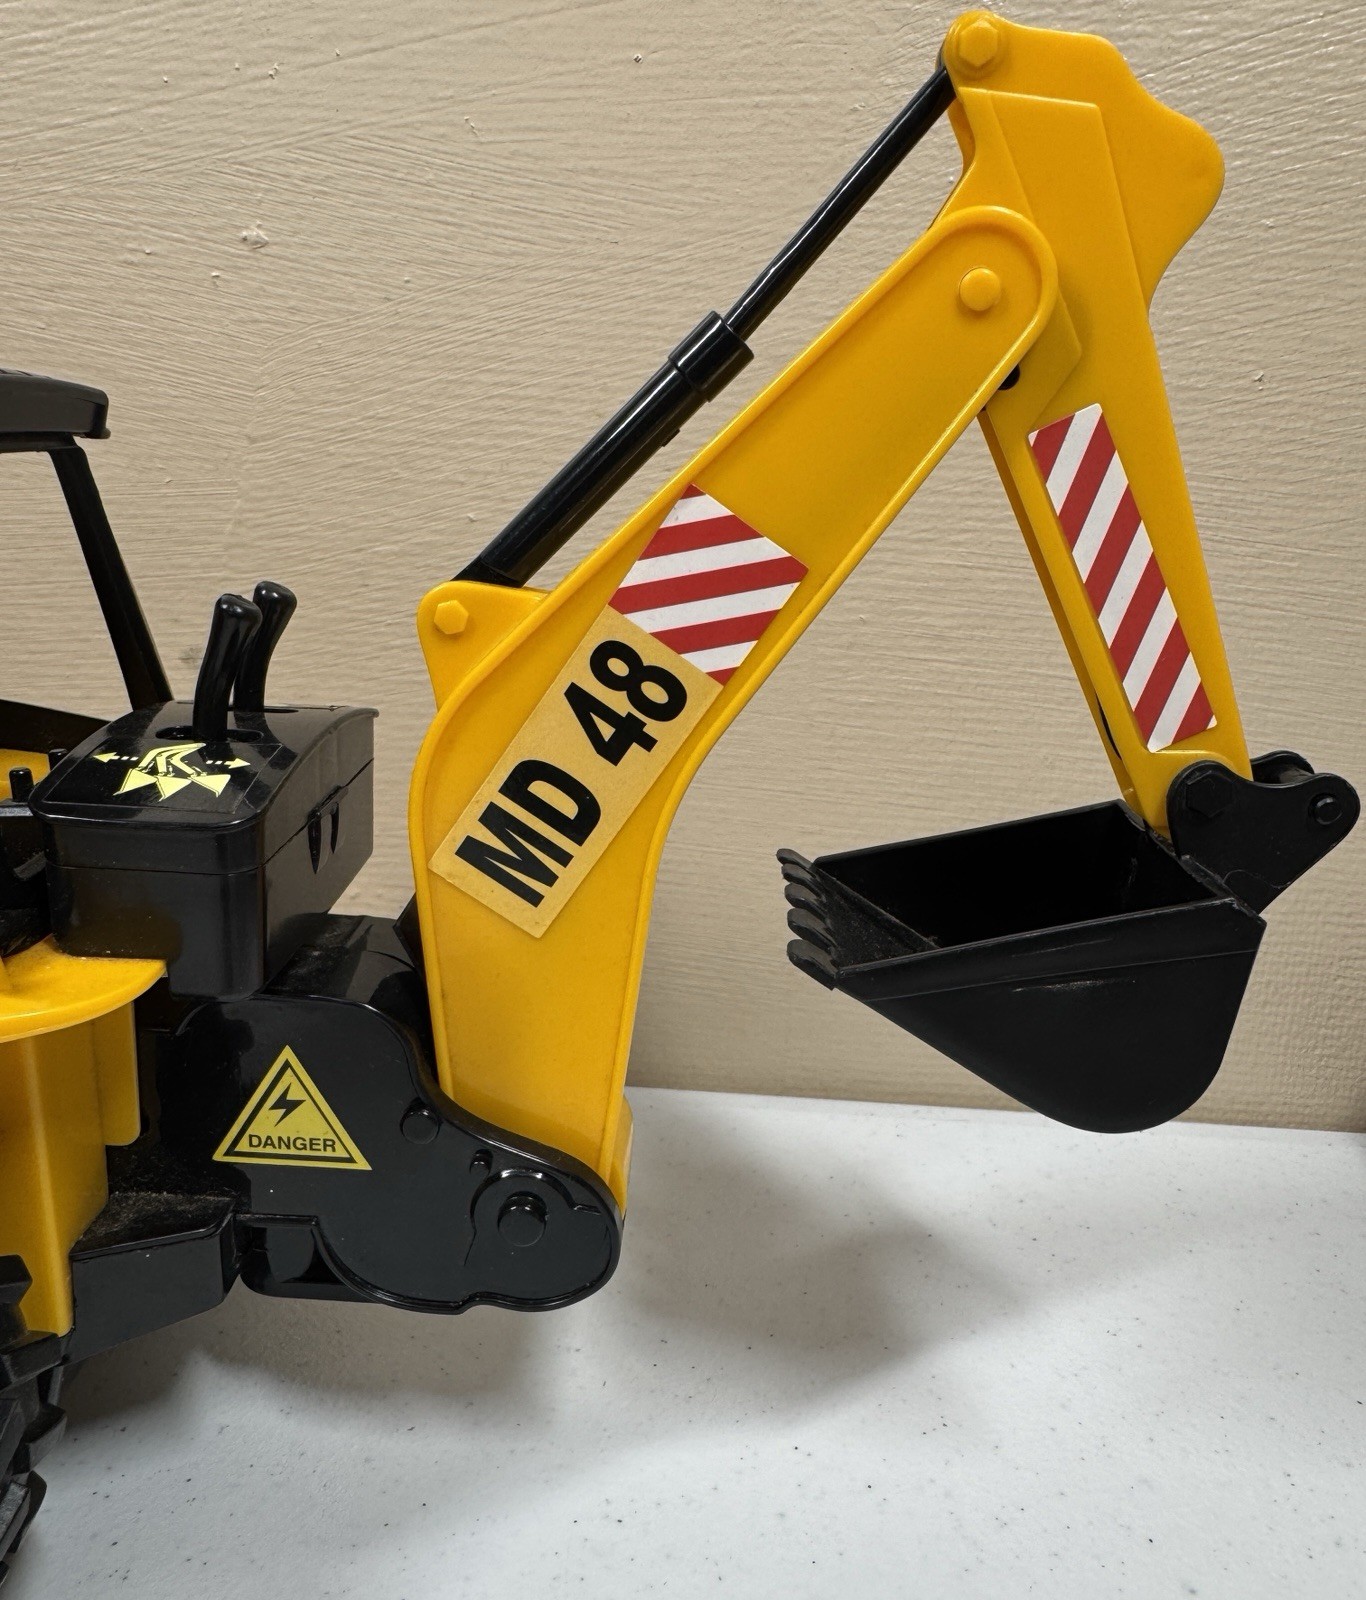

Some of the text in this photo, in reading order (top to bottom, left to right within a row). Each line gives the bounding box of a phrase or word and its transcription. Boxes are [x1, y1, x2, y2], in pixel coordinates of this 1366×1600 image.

[455, 640, 687, 908] MD 48
[248, 1134, 336, 1153] DANGER
